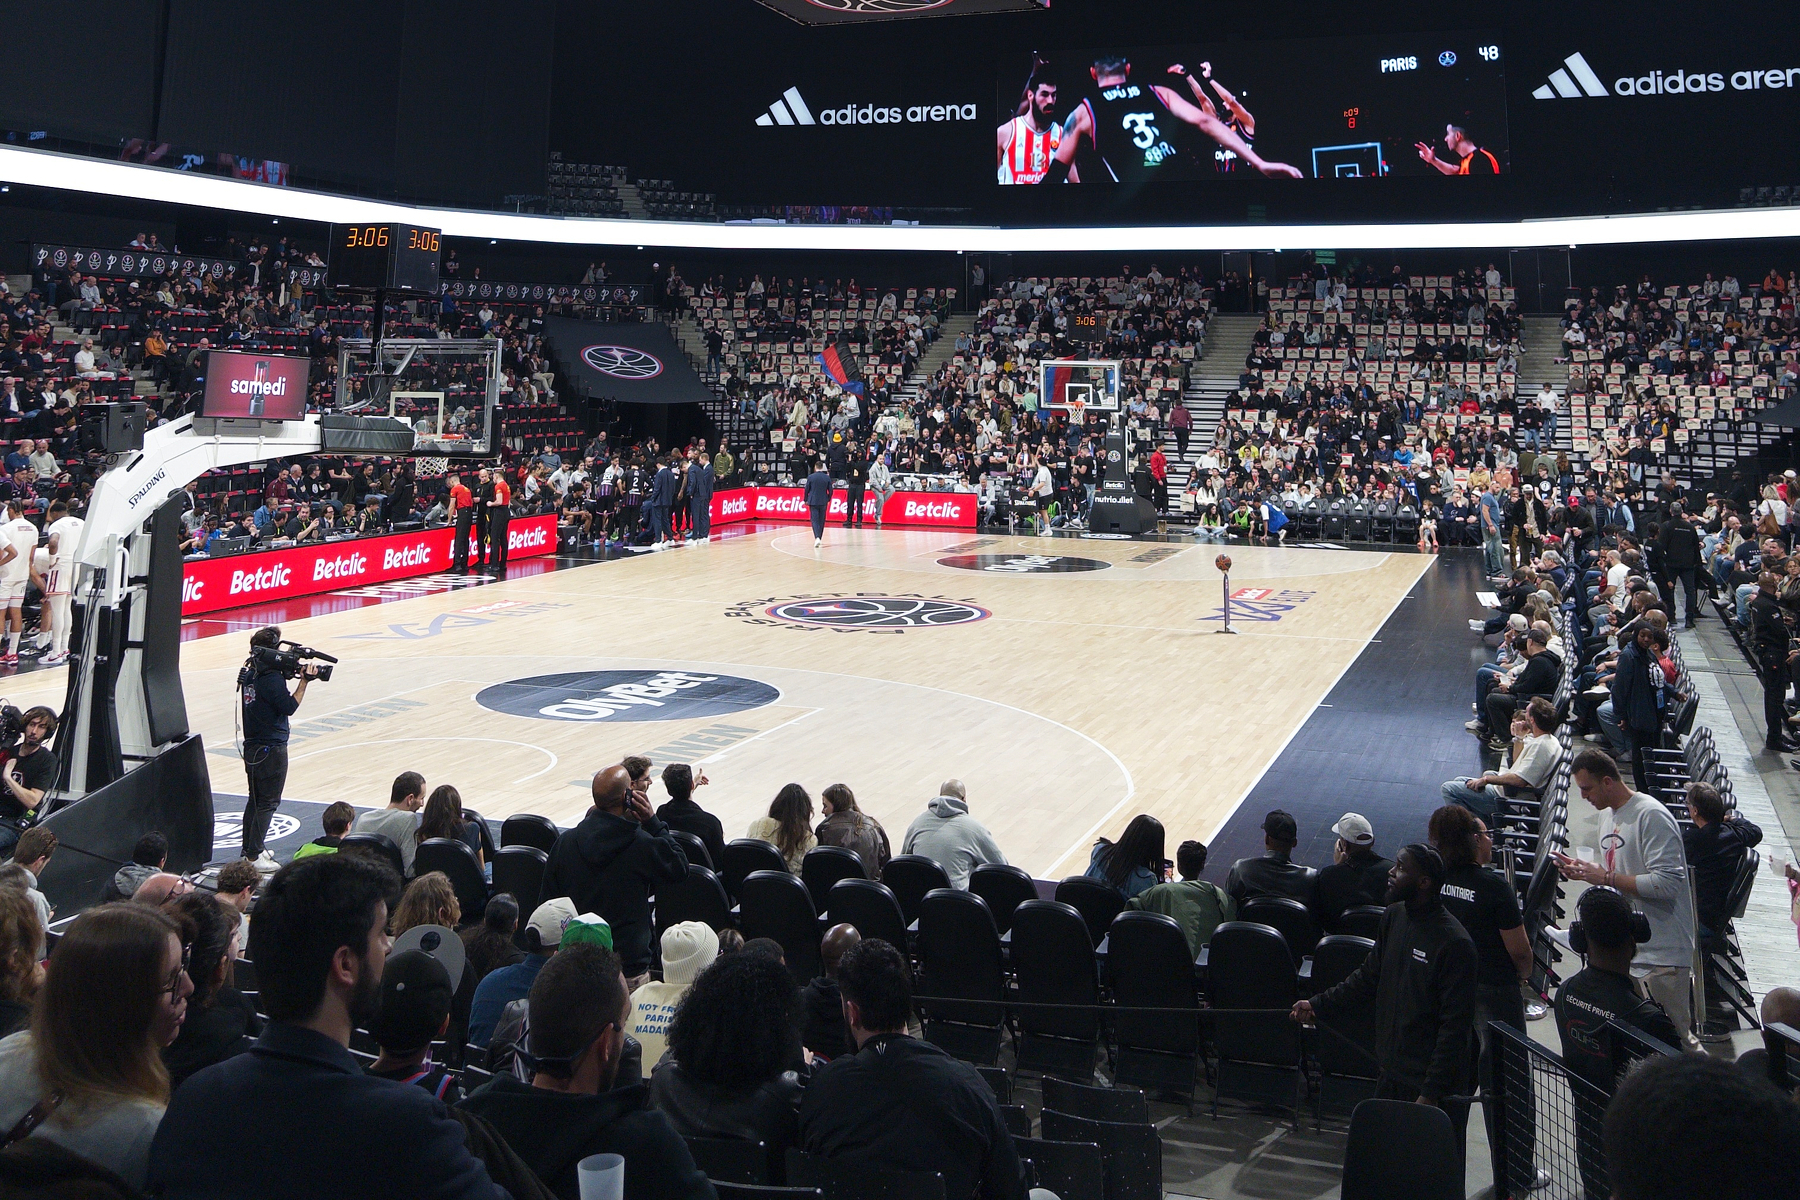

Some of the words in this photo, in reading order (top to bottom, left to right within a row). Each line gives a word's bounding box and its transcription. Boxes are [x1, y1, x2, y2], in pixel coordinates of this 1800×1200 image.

[1381, 56, 1418, 73] PARIS
[1478, 45, 1499, 61] 48
[1614, 69, 1725, 97] adidas
[1730, 66, 1800, 91] aren
[819, 103, 903, 126] adidas
[906, 103, 977, 123] arena
[1348, 117, 1356, 129] 8
[346, 227, 389, 247] 3:06
[408, 229, 440, 252] 3:06
[1075, 316, 1096, 326] 3:06
[230, 377, 286, 396] samedi
[128, 467, 166, 509] SPALDING
[632, 477, 639, 487] 2
[721, 498, 748, 516] Betclic
[756, 495, 807, 513] Betclic
[904, 500, 961, 519] Betclic
[508, 526, 547, 550] Betclic
[312, 553, 366, 581] Betclic
[383, 544, 431, 570] Betclic
[229, 562, 291, 595] Betclic
[538, 672, 719, 720] OlyBet
[638, 1003, 658, 1011] NOT
[645, 1014, 673, 1023] PARIS
[1566, 994, 1593, 1012] SÉCURITÉ
[1591, 1006, 1616, 1021] PRIVÉE
